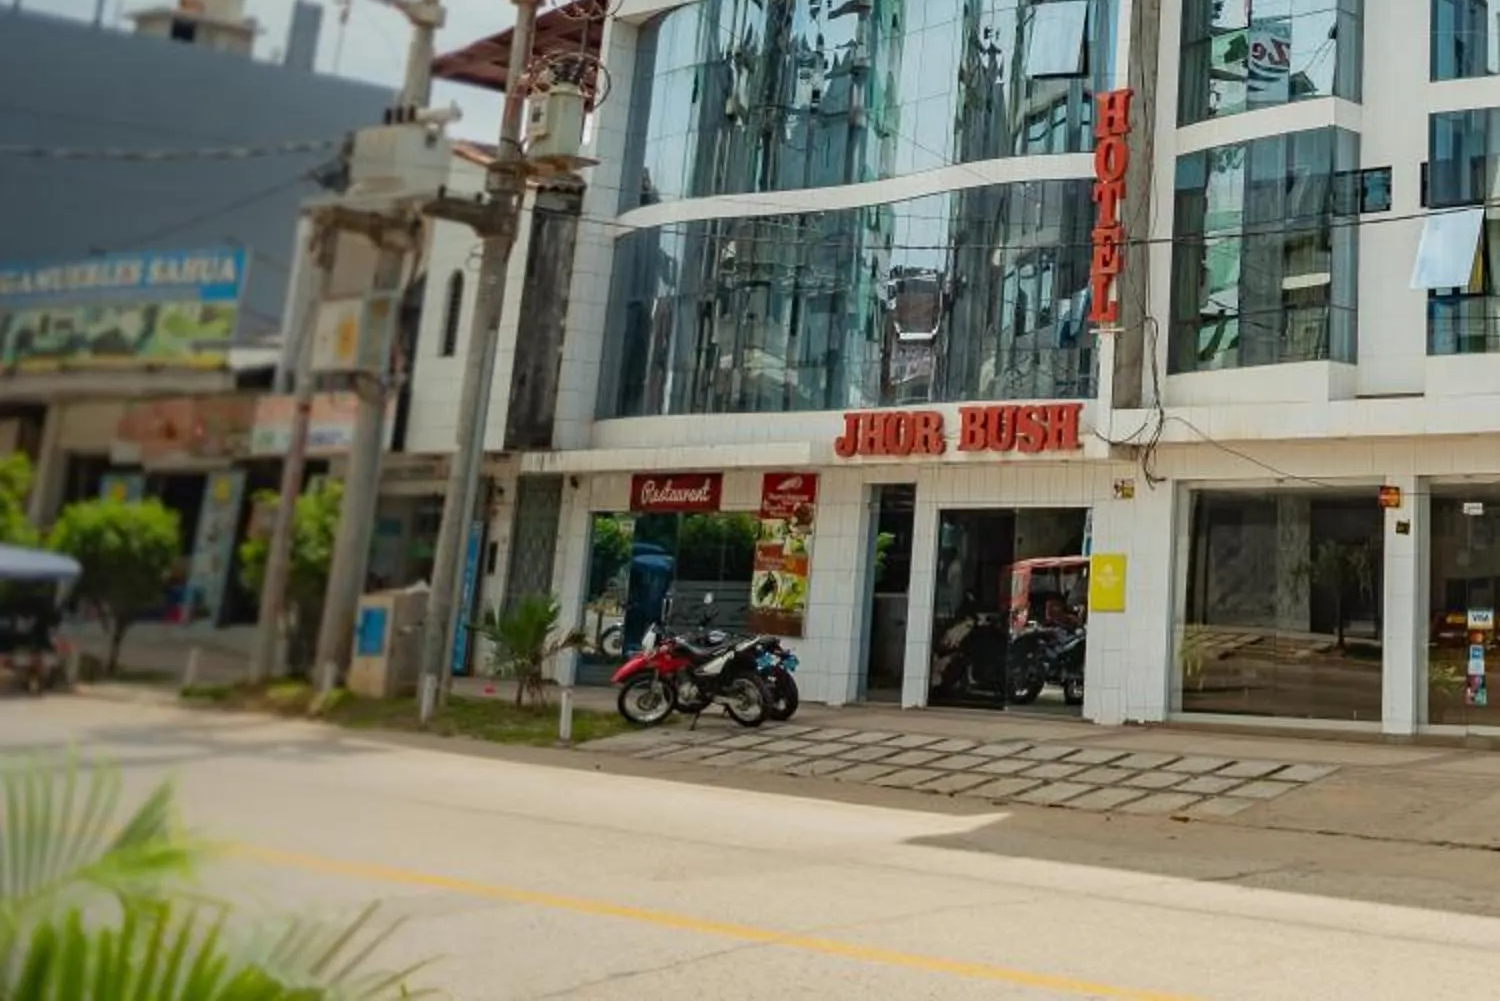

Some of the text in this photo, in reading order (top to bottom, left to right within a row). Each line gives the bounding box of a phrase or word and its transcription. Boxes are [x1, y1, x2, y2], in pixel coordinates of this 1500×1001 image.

[1090, 88, 1134, 323] HOTEL
[835, 403, 1084, 457] JHOR BUSH
